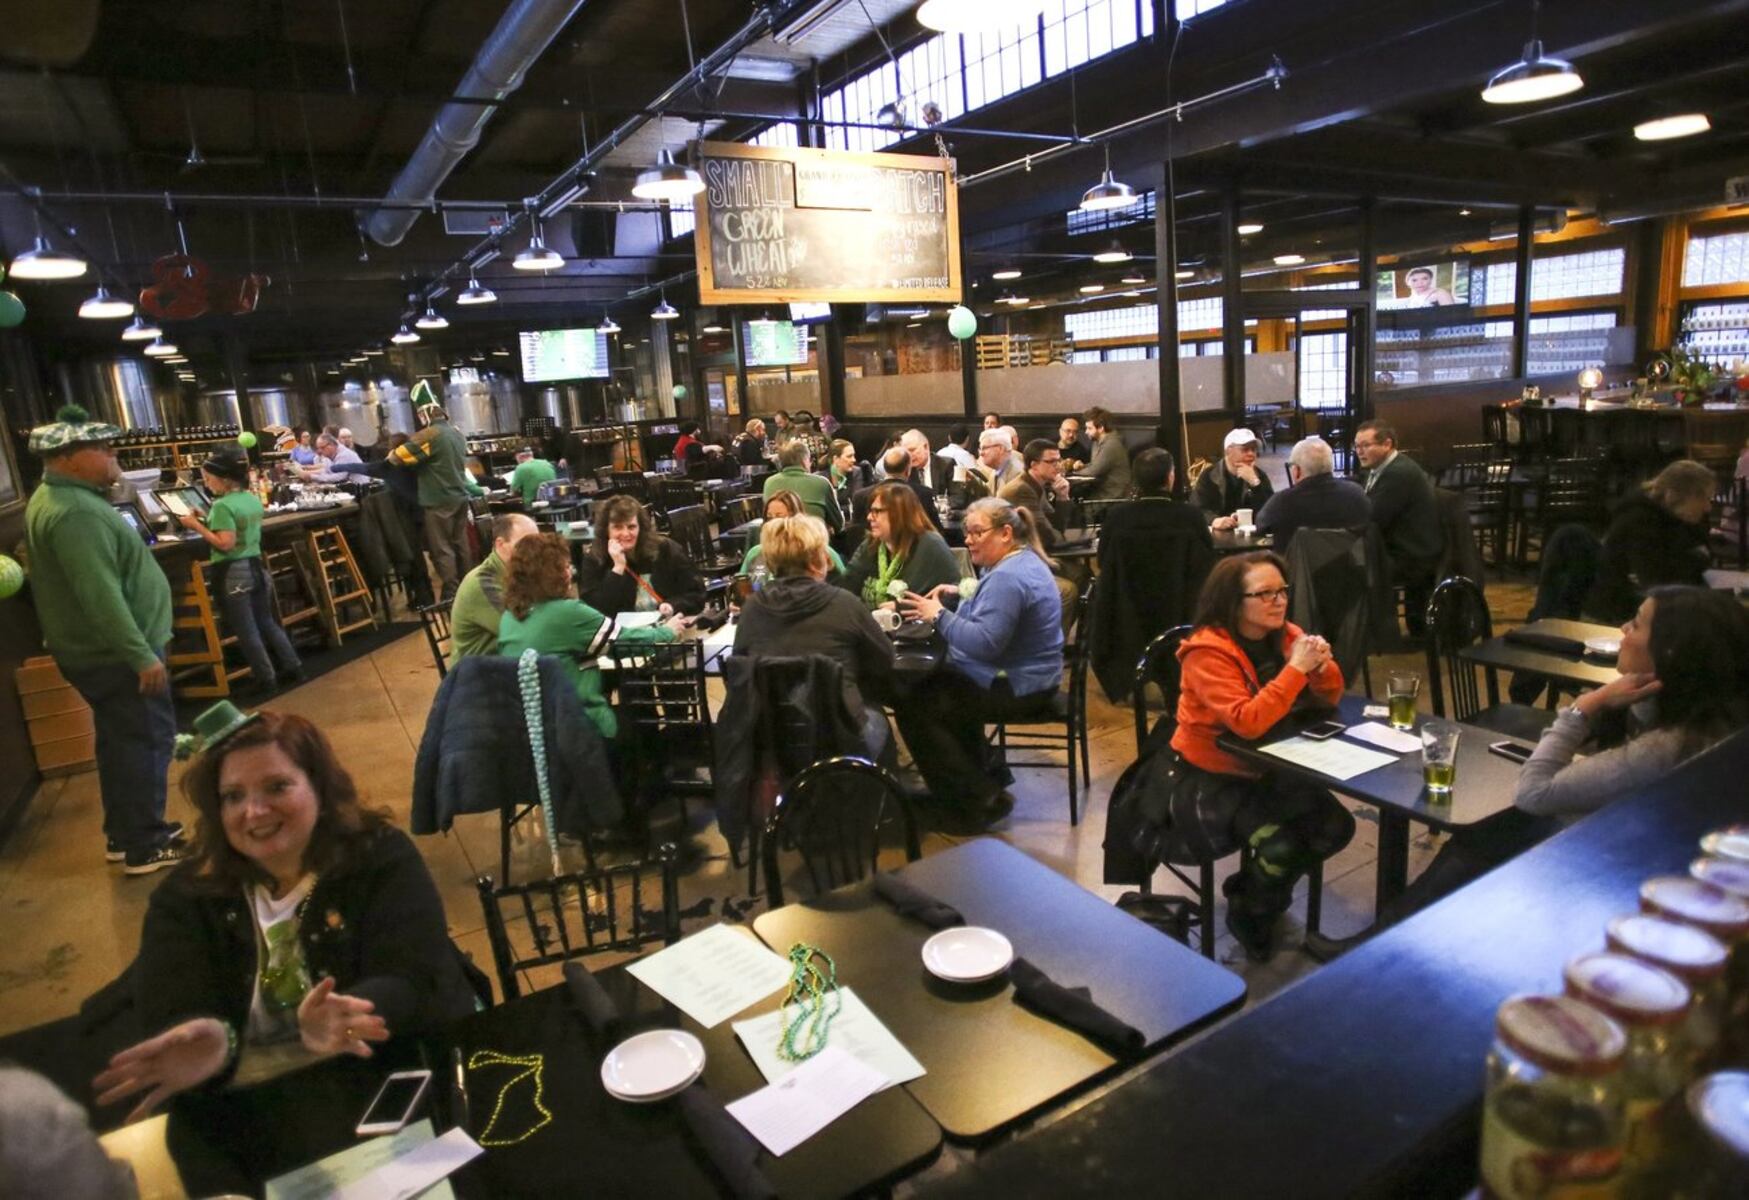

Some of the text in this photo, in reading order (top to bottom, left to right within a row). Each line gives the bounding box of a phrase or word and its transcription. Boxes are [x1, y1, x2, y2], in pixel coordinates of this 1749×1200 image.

[706, 159, 944, 213] SMALL ATCH
[723, 208, 784, 241] GREEN
[727, 238, 788, 275] WHEAT
